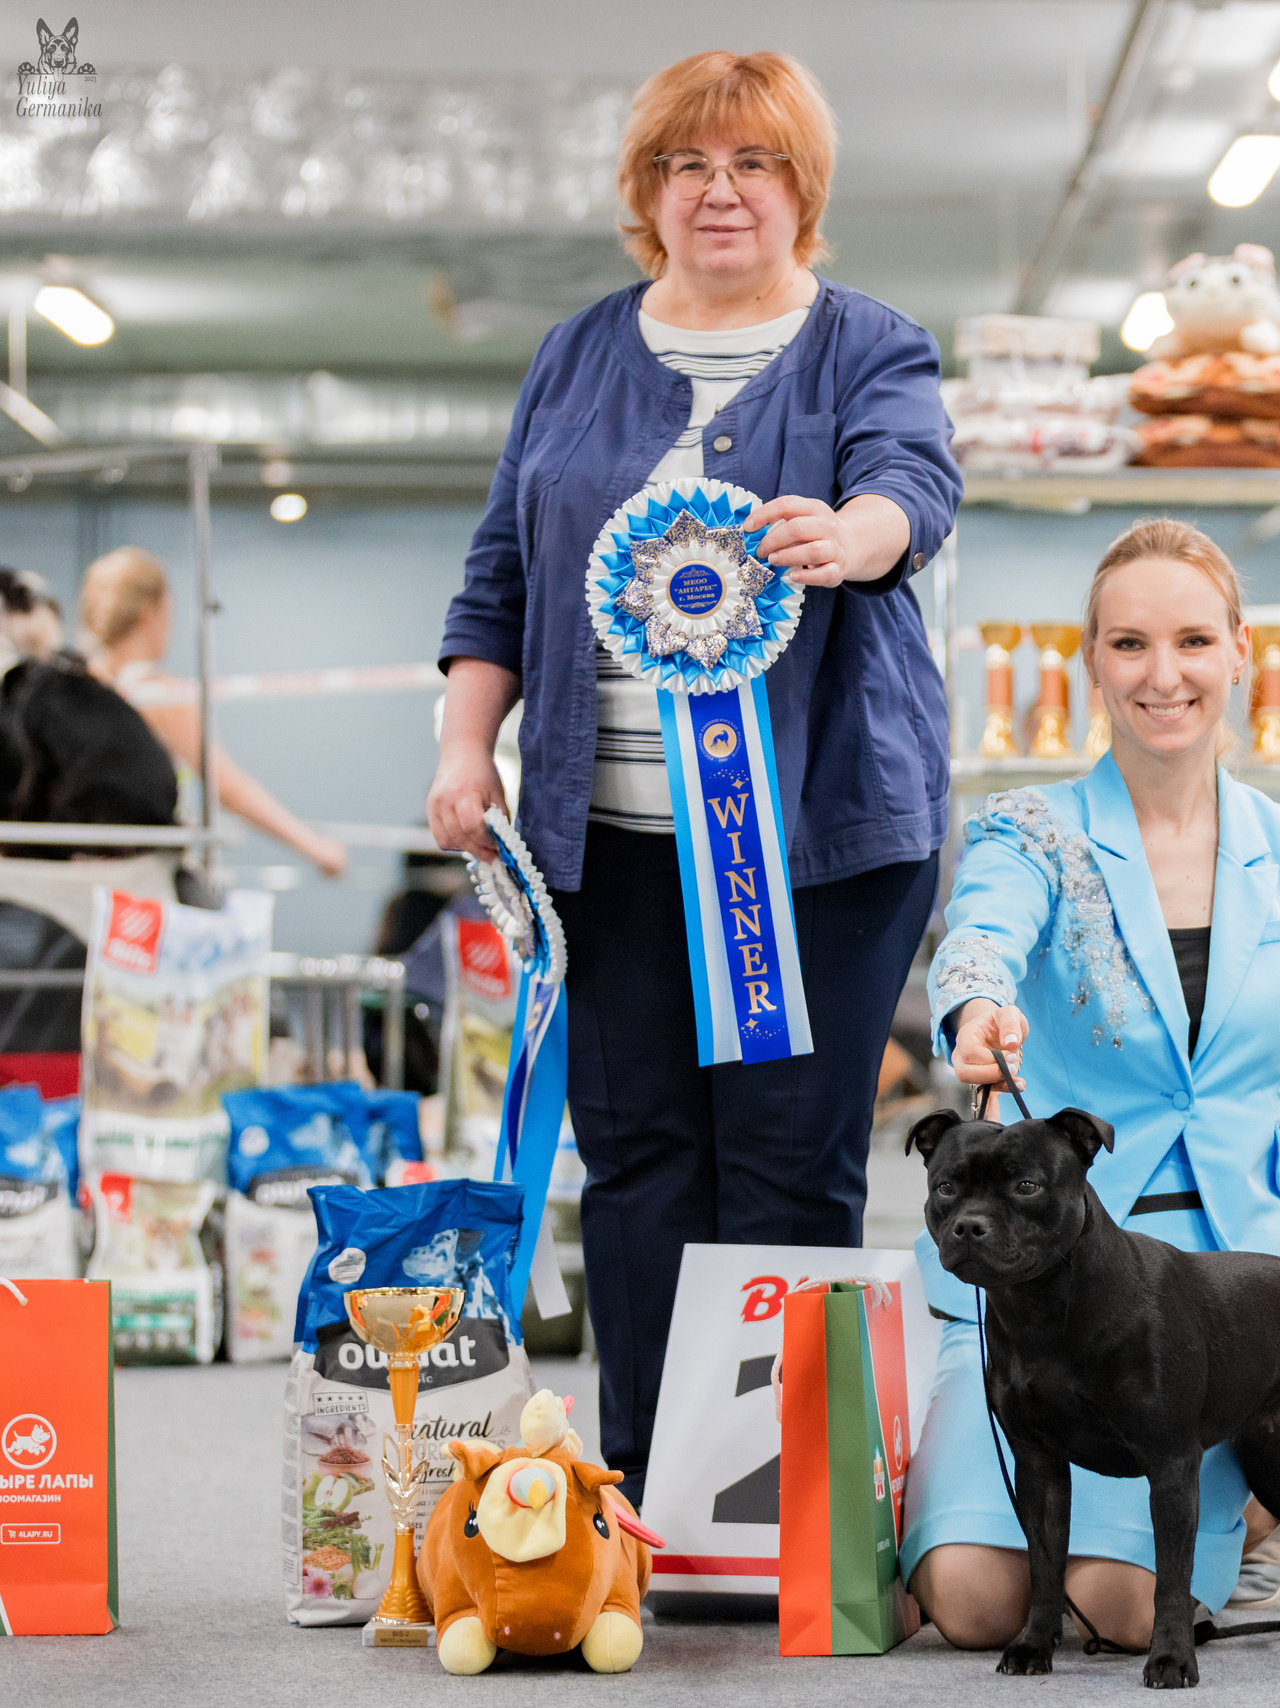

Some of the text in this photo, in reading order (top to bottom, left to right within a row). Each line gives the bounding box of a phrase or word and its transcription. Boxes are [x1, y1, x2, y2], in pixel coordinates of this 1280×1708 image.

[686, 593, 716, 601] Москва
[707, 793, 778, 1015] WINNER
[338, 1335, 477, 1370] oat
[316, 1403, 367, 1415] INGREDIENTS
[38, 1474, 94, 1489] ЛАПЫ
[18, 1530, 53, 1538] 4LAPY.RU
